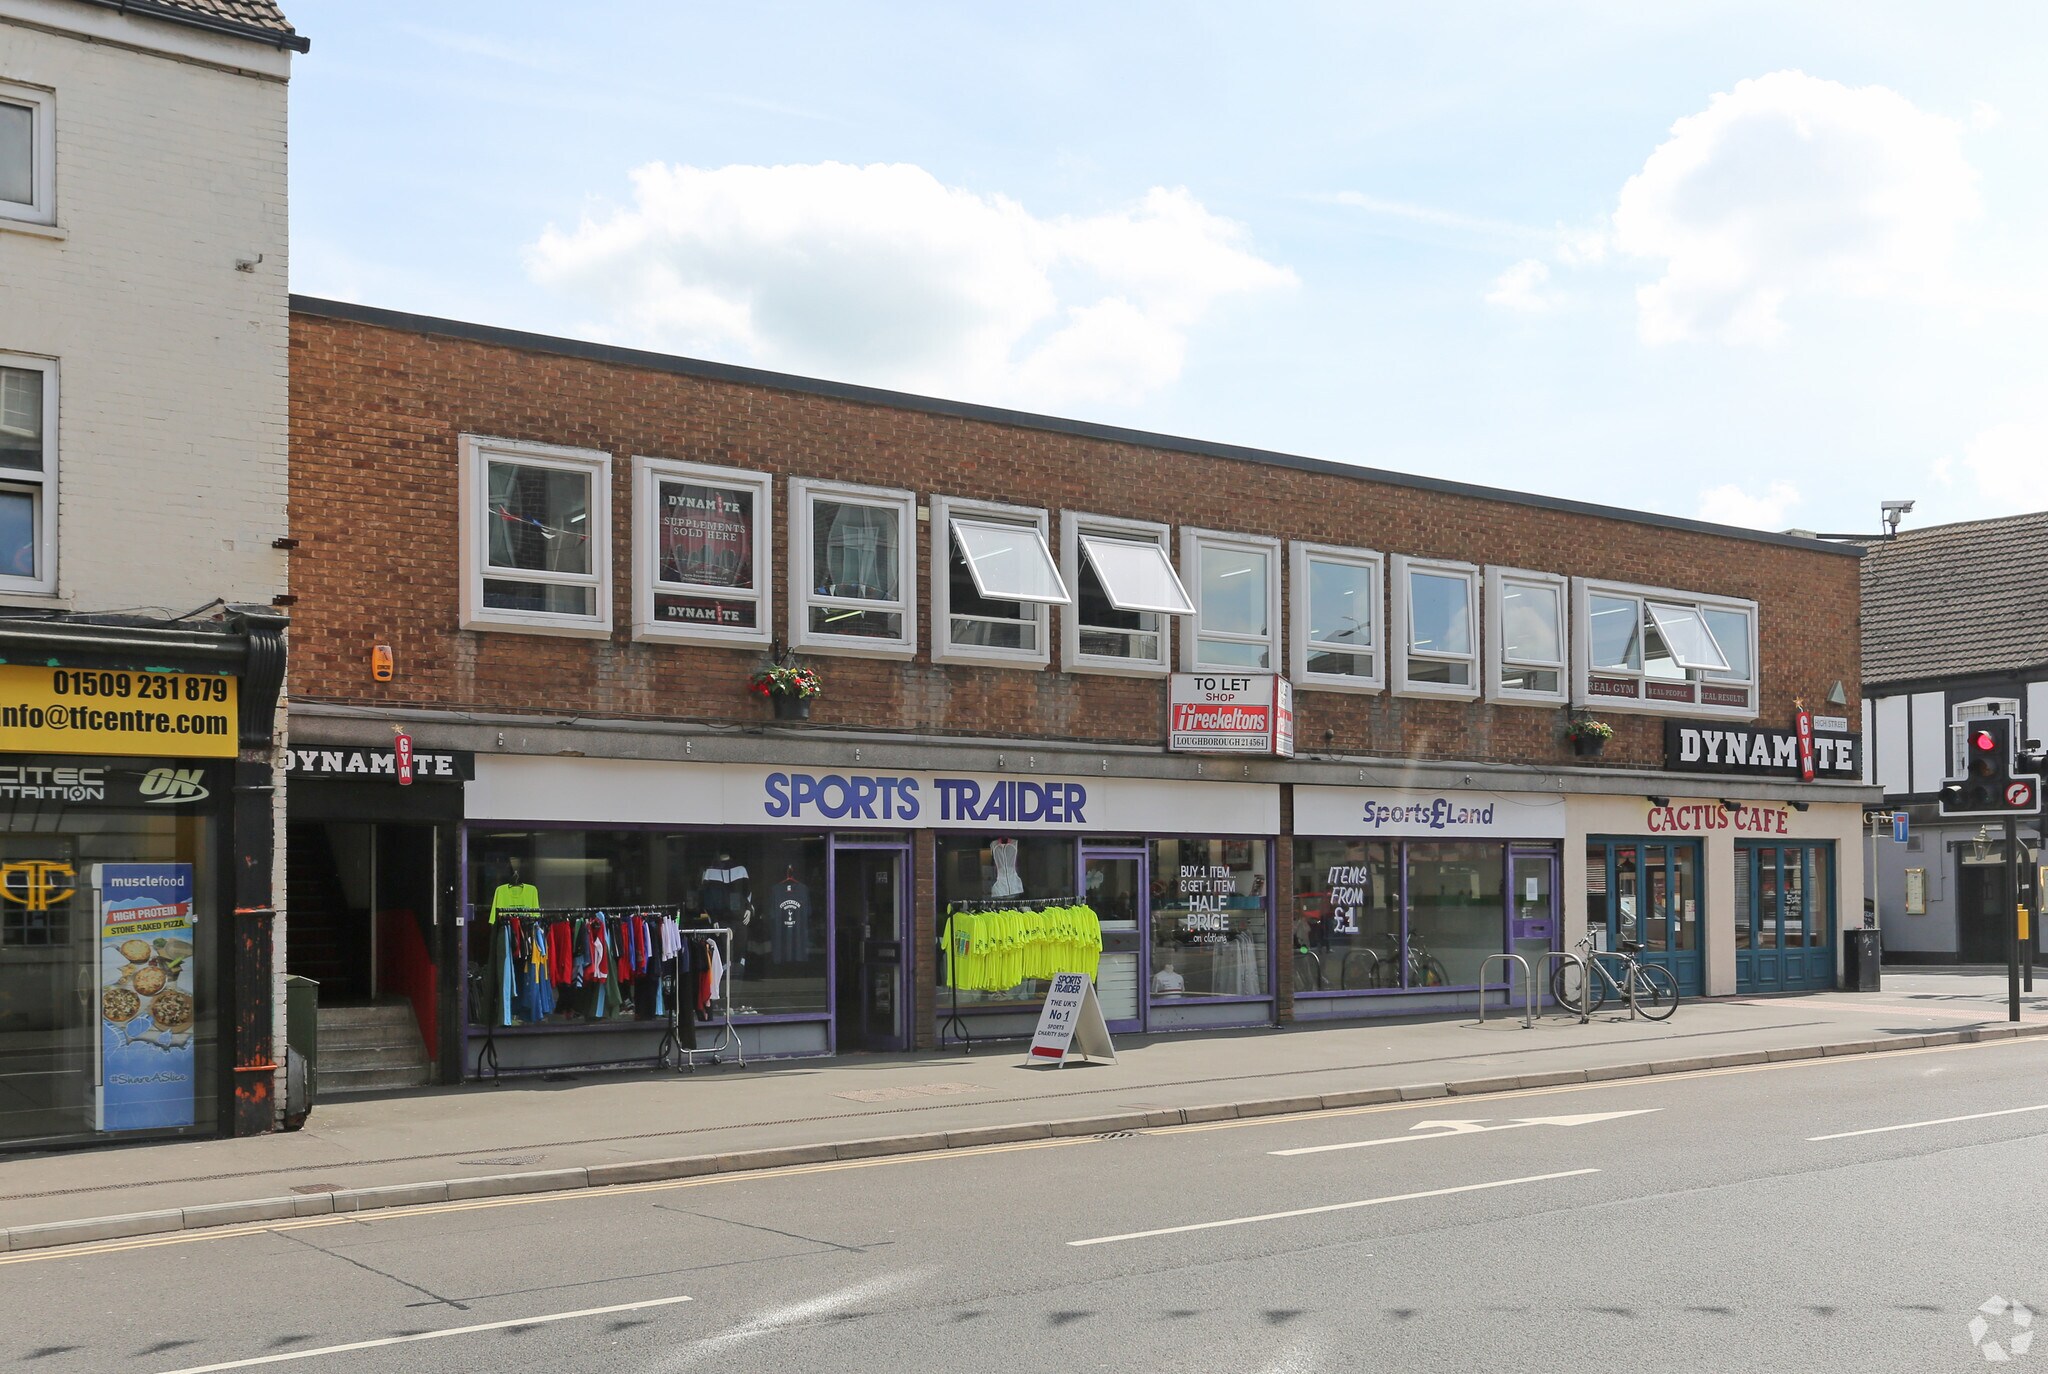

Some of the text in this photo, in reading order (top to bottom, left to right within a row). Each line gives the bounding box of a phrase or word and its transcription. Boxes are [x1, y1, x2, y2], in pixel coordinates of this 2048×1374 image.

[664, 517, 746, 534] SUPPLEMENTS
[673, 527, 737, 541] SOLD HERE
[53, 670, 227, 702] 01509 231 879
[1194, 678, 1251, 691] TO LET
[1588, 681, 1634, 694] REAL GYM
[1205, 692, 1235, 702] SHOP
[1665, 689, 1687, 697] PEOPLE
[1700, 690, 1745, 703] REAL RESULTS
[0, 704, 228, 735] nfo@tfcentre.com
[1815, 719, 1847, 729] HIGH STREET
[1176, 736, 1240, 746] LOUGHBOROUGH
[1800, 715, 1814, 773] GYM
[399, 737, 411, 778] GYM
[139, 768, 206, 796] ON
[0, 785, 104, 801] TRITION
[764, 772, 1087, 823] SPORTS TRAIDER
[1647, 805, 1788, 835] CACTUS CAFÉ
[1180, 865, 1199, 878] BUY
[1200, 867, 1206, 878] 1
[1327, 866, 1367, 884] ITEMS
[111, 875, 185, 888] musclefood
[1180, 880, 1236, 892] & GET 1 ITEM
[1330, 886, 1364, 905] FROM
[1189, 895, 1227, 912] HALF
[113, 906, 177, 921] HIGH PROTEIN
[1334, 906, 1359, 934] £1
[111, 919, 184, 935] STONE BAKED PIZZA
[1187, 913, 1229, 931] PRICE
[1203, 932, 1227, 944] clothing
[1057, 975, 1082, 984] SPORTS
[1054, 983, 1081, 994] TRAIDER
[1050, 999, 1062, 1007] THE
[1049, 1009, 1070, 1022] No 1
[110, 1072, 187, 1085] #ShareASlice
